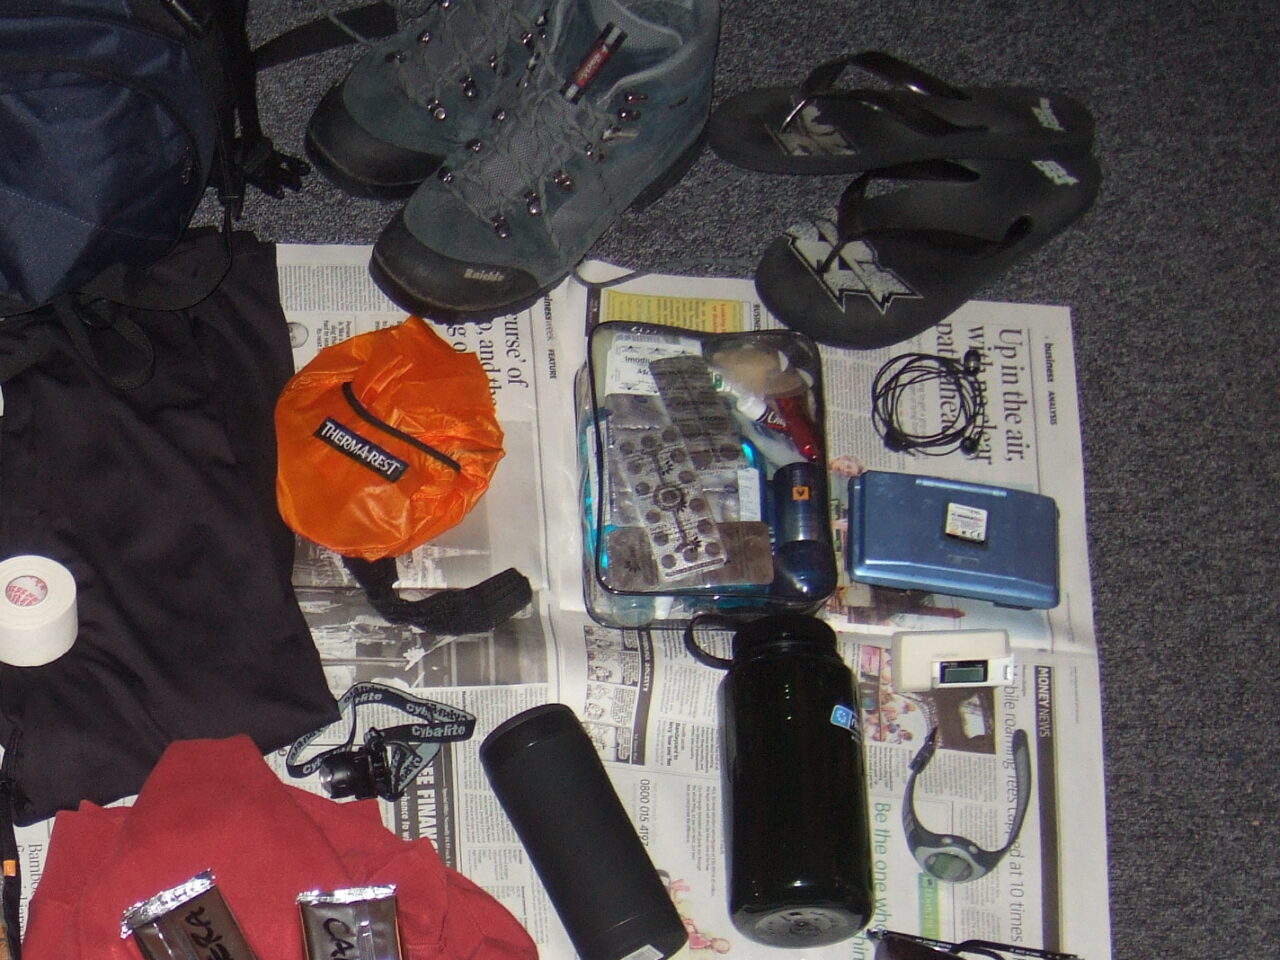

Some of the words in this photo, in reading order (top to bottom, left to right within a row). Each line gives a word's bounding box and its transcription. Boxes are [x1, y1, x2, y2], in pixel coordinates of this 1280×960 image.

[480, 339, 501, 374] and
[994, 329, 1023, 360] Up
[507, 367, 529, 388] of
[1001, 365, 1025, 384] in
[1003, 391, 1028, 424] the
[318, 421, 402, 477] THERMA-REST
[1004, 429, 1030, 462] air,
[1038, 667, 1050, 708] MONEY
[1039, 708, 1051, 738] NEWS
[639, 779, 650, 803] 0800
[416, 789, 439, 853] FINAN
[639, 806, 650, 821] 015
[874, 802, 891, 824] Be
[874, 828, 891, 855] the
[874, 860, 888, 892] one
[1009, 862, 1023, 879] at
[1010, 882, 1024, 898] 10
[1010, 901, 1026, 942] times
